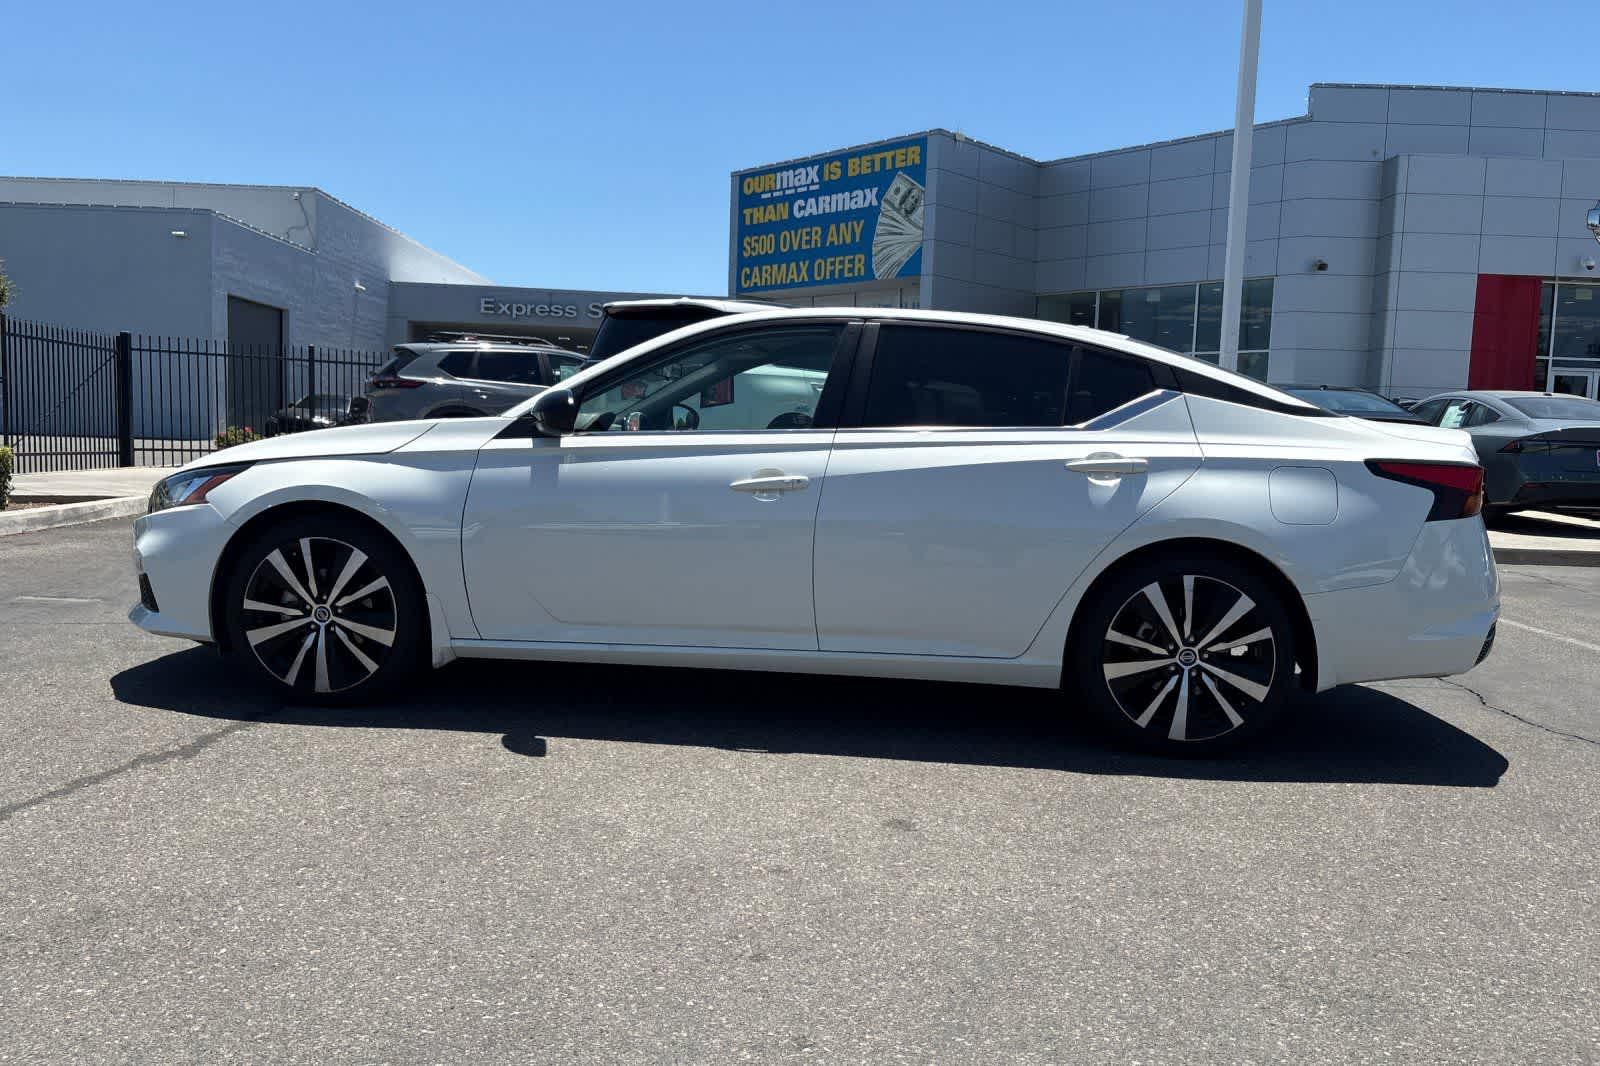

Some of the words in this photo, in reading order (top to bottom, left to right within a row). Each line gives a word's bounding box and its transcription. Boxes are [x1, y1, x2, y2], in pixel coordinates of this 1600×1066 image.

[824, 161, 841, 180] IS
[848, 146, 920, 176] BETTER
[743, 202, 789, 224] THAN
[743, 234, 775, 257] $500
[780, 227, 821, 252] OVER
[826, 220, 864, 246] ANY
[741, 260, 809, 288] CARMAX
[814, 254, 865, 282] OFFER
[480, 297, 577, 320] Express
